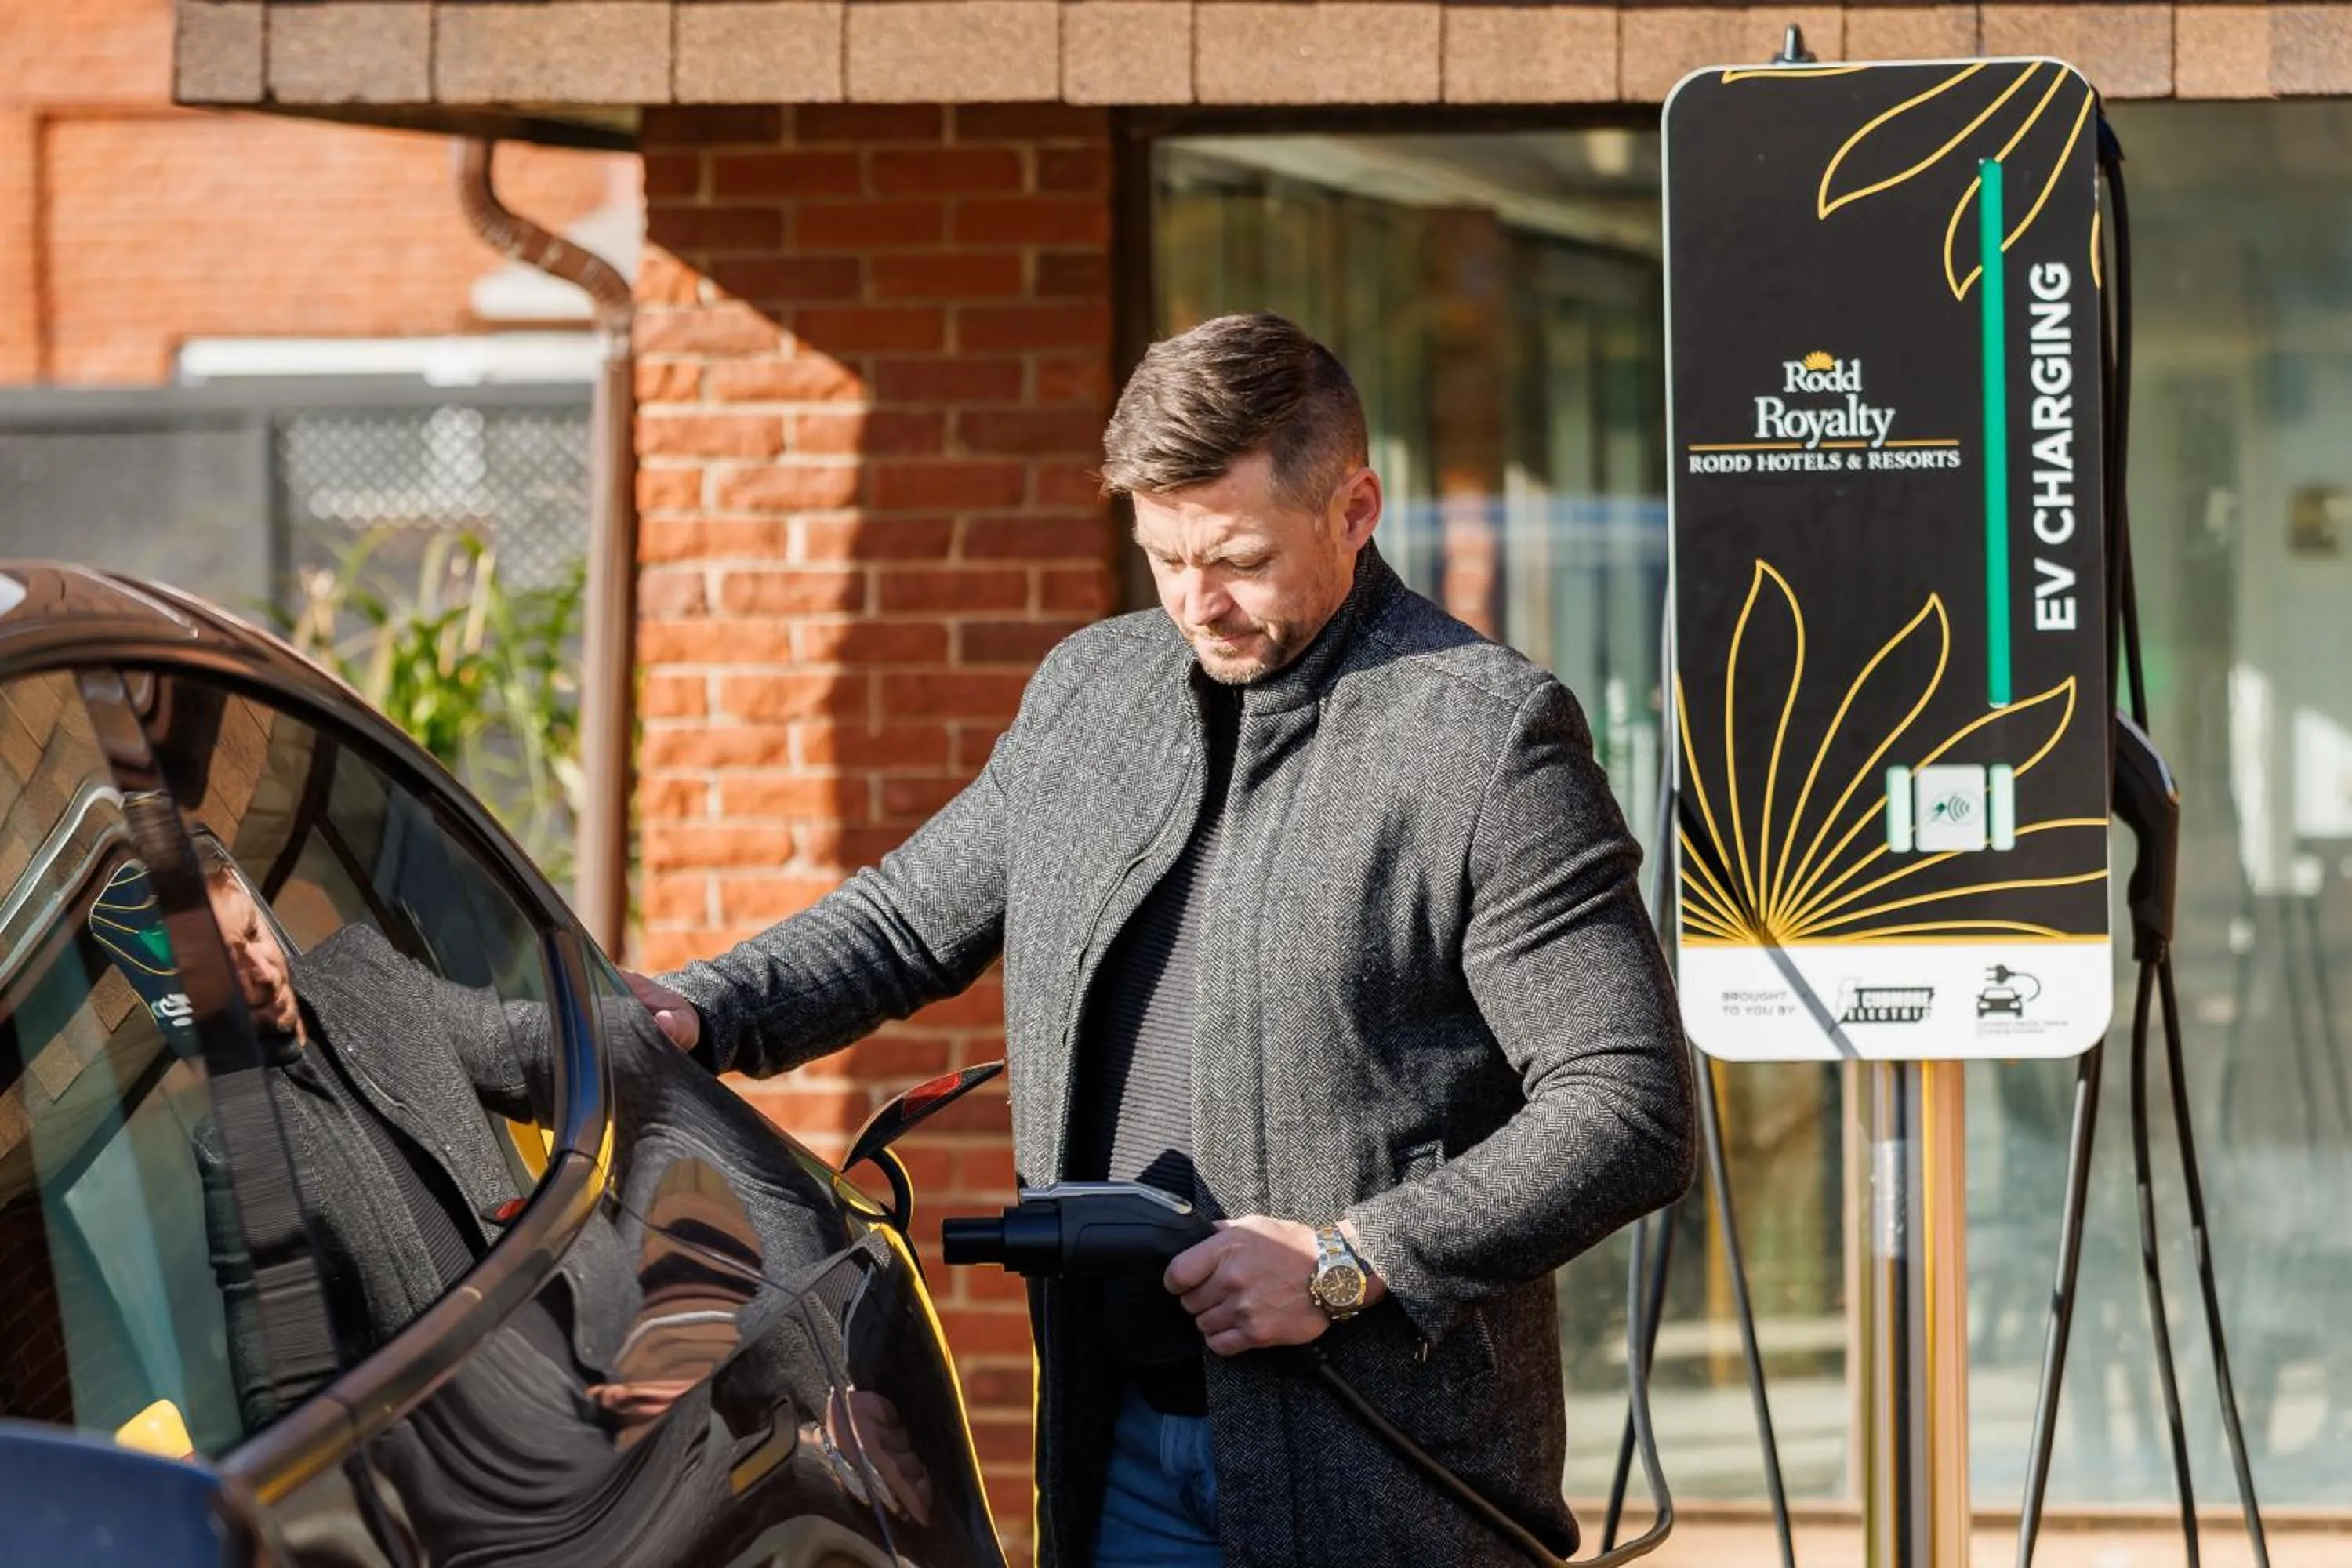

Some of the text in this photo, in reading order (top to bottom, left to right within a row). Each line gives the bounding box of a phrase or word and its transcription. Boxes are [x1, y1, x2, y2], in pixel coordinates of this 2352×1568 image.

[1783, 358, 1863, 393] Rodd
[1754, 394, 1896, 449] Royalty
[1688, 449, 1961, 473] RODD HOTELS & RESORTS
[2028, 261, 2077, 630] EV CHARGING
[1723, 1005, 1795, 1017] TO YOU BY
